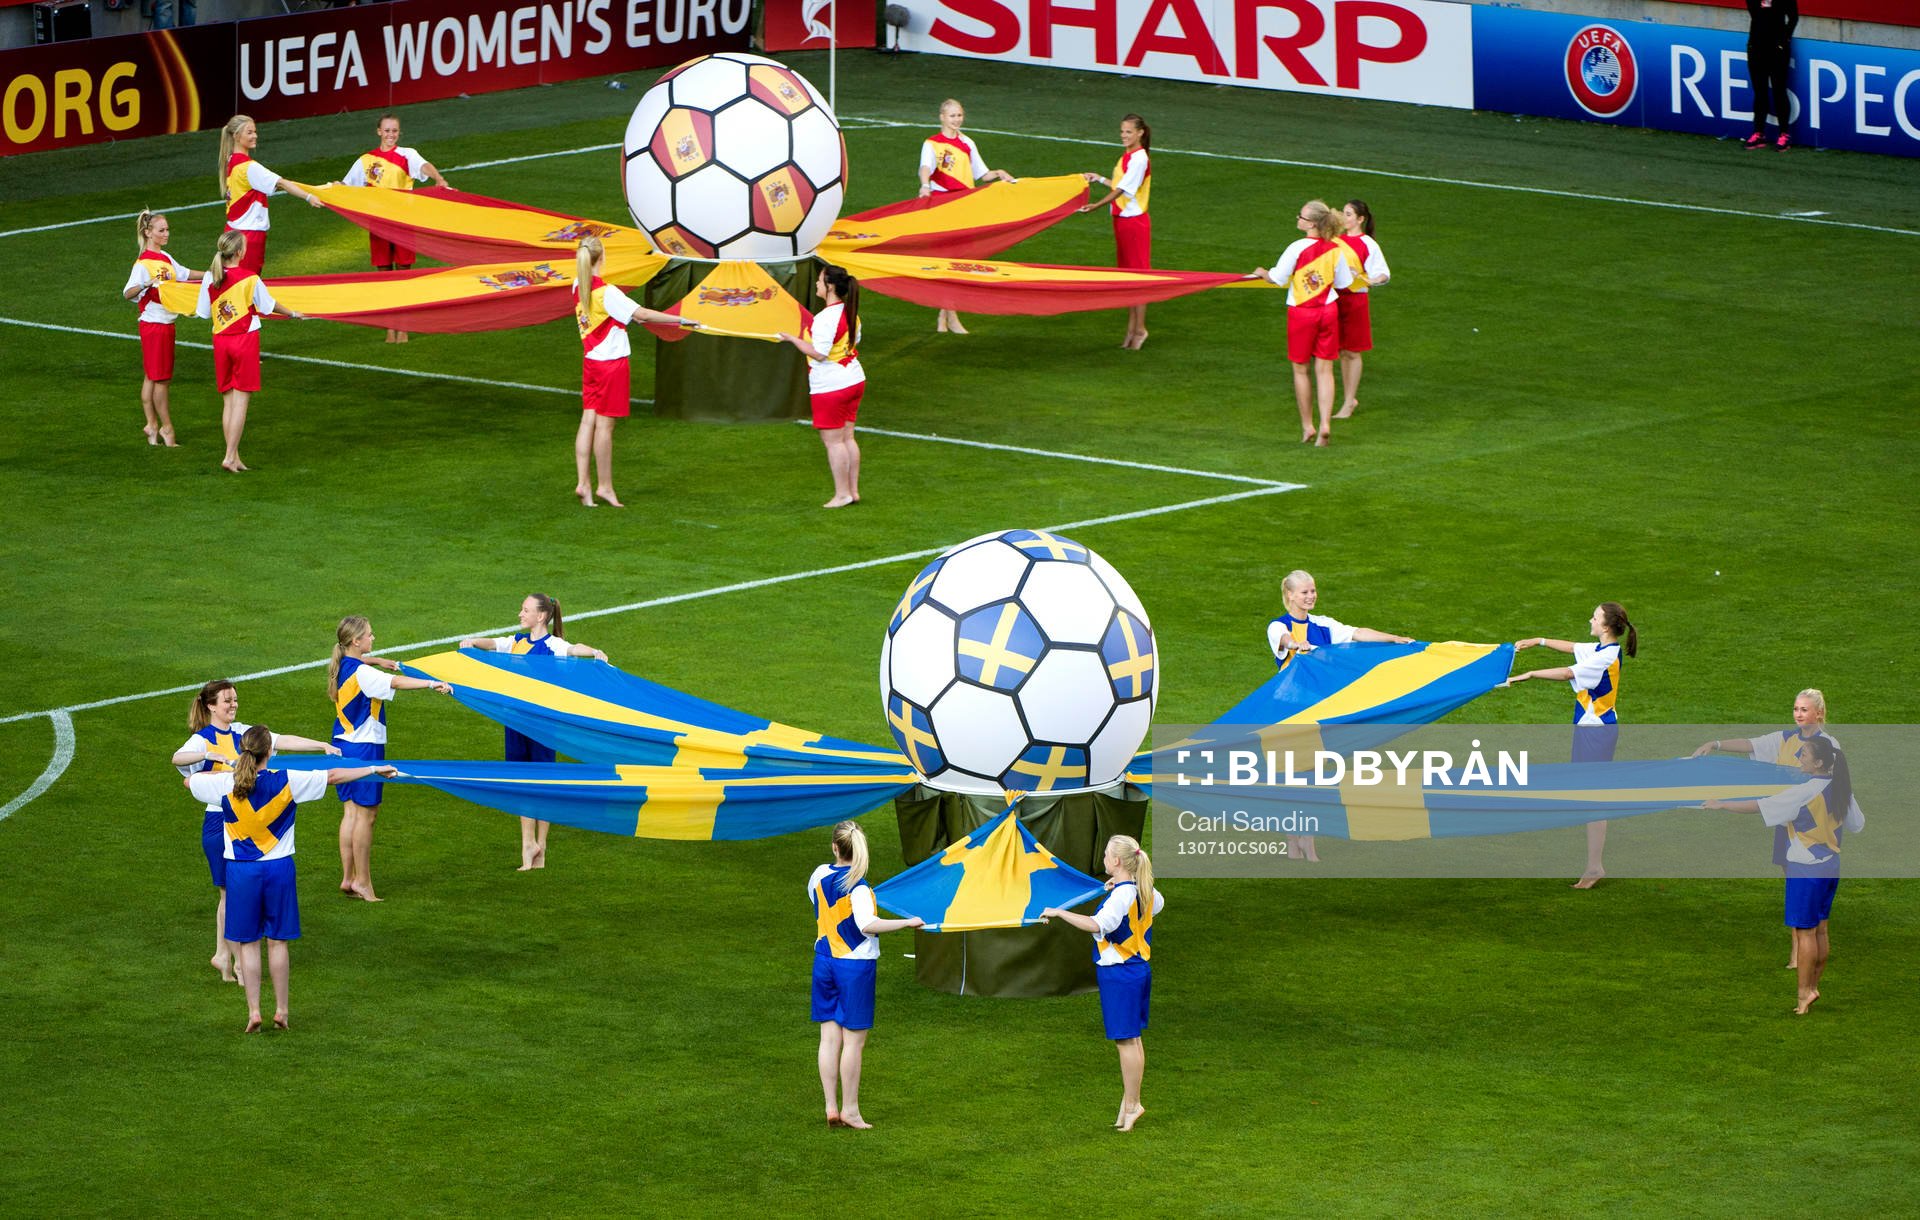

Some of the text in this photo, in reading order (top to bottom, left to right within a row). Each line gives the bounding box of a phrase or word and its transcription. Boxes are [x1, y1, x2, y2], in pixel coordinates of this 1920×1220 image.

[240, 0, 749, 101] UEFA WOMEN'S EURO
[928, 0, 1428, 90] SHARP
[1578, 30, 1622, 53] UEFA
[2, 61, 141, 144] ORG
[1670, 44, 1920, 142] REPEC
